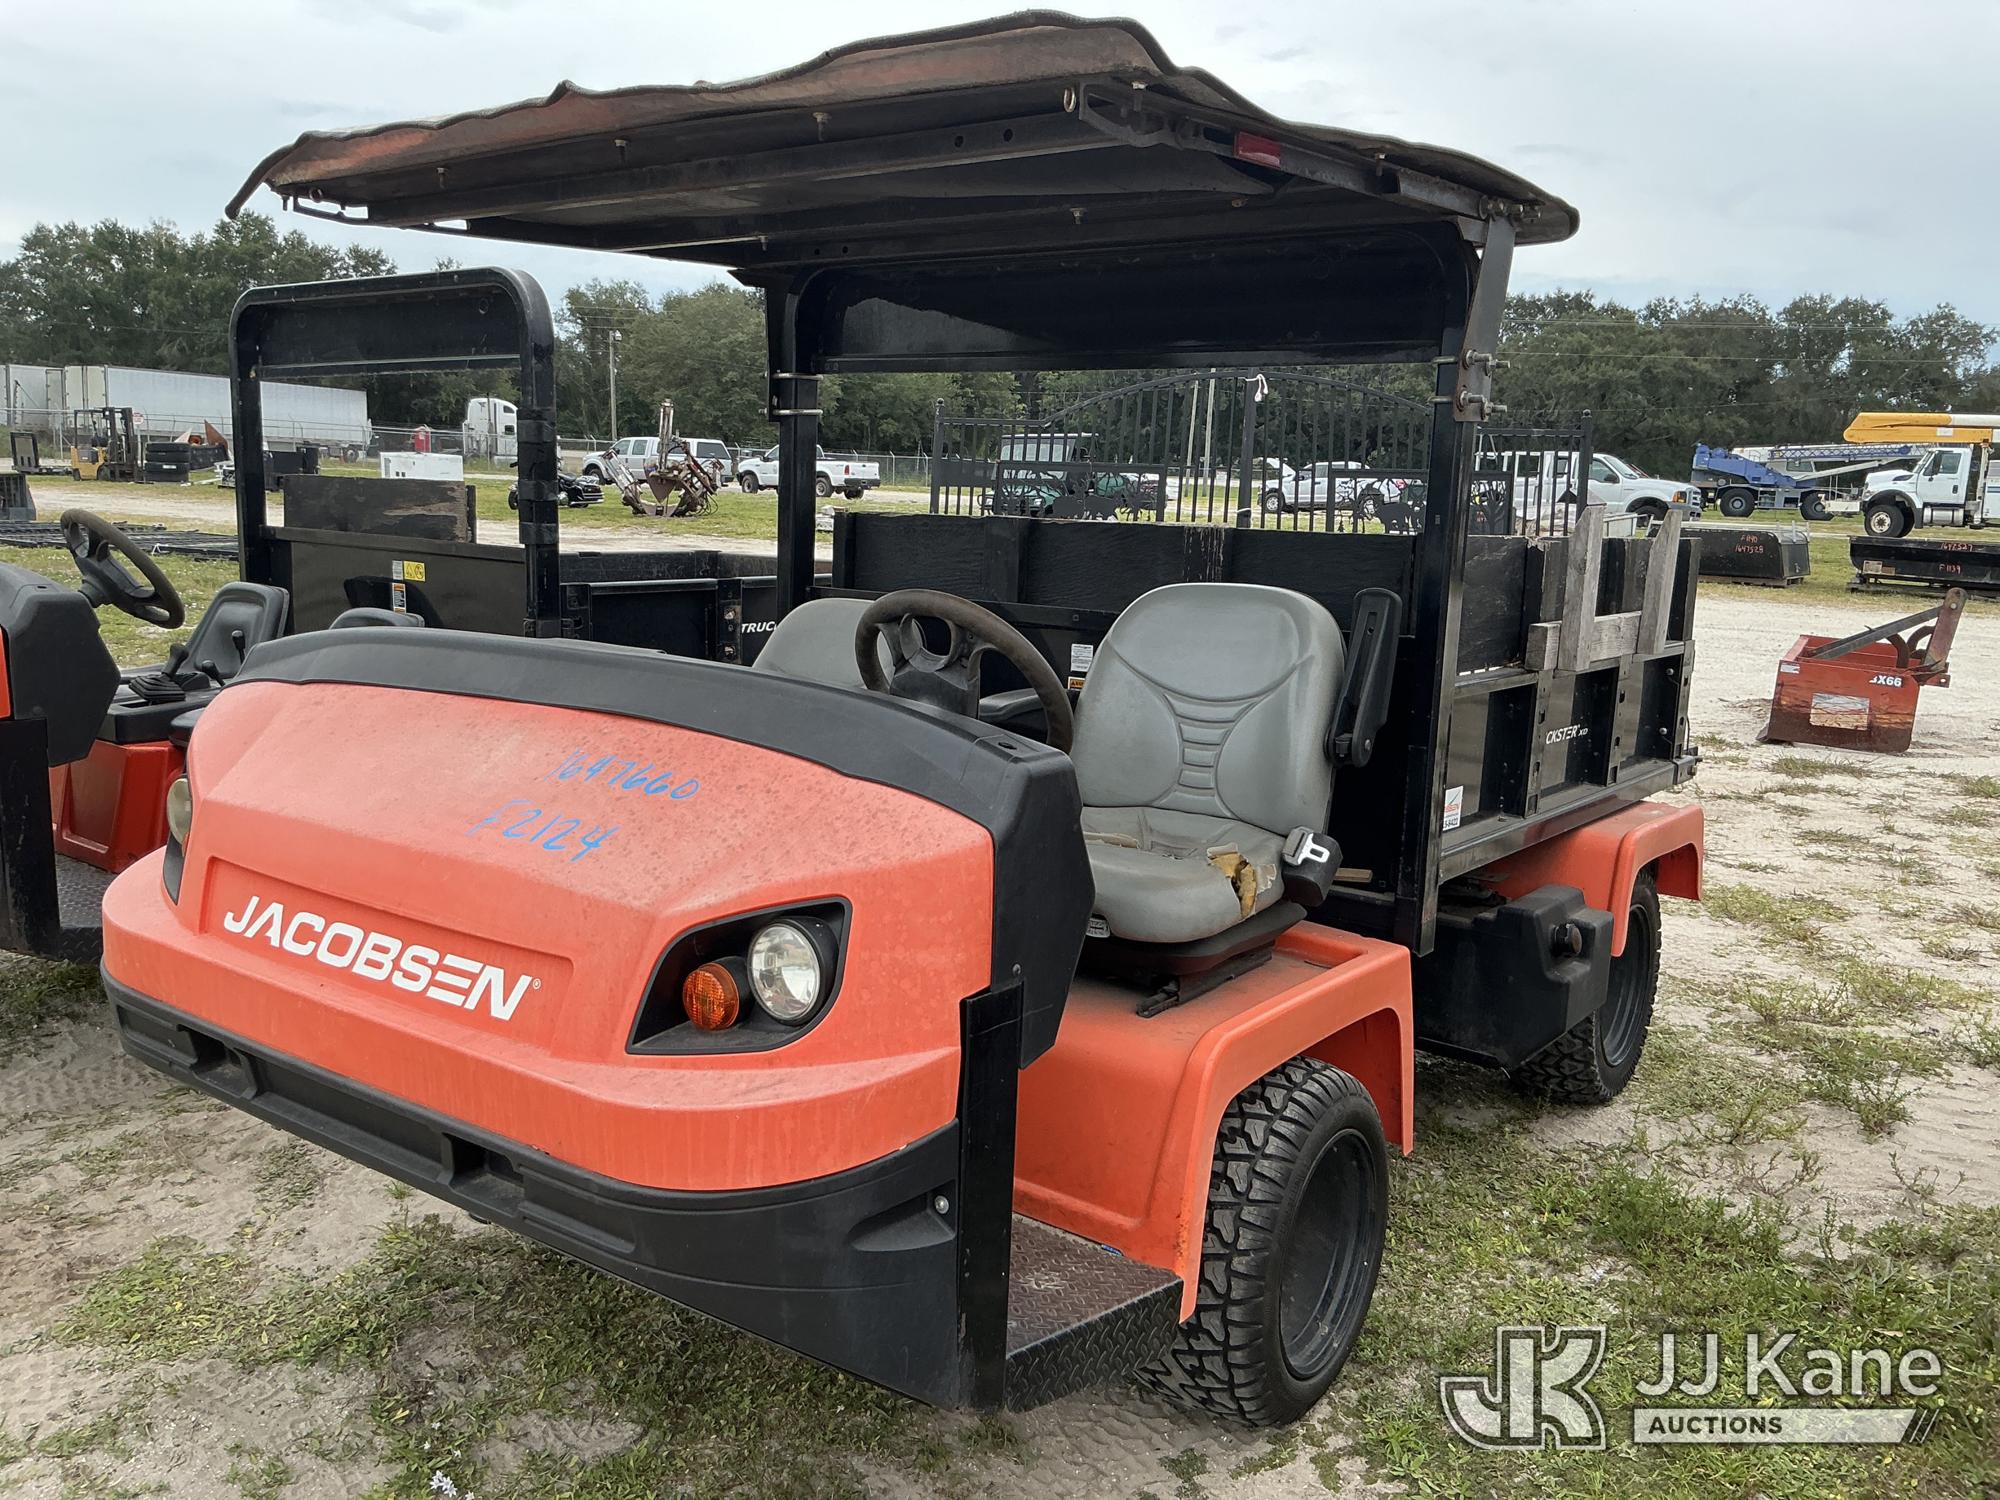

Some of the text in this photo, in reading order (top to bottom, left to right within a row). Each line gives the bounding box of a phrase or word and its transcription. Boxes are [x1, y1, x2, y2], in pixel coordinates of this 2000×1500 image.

[543, 749, 701, 800] 1647660
[464, 799, 621, 863] F2124
[223, 895, 534, 1022] JACOBSEN
